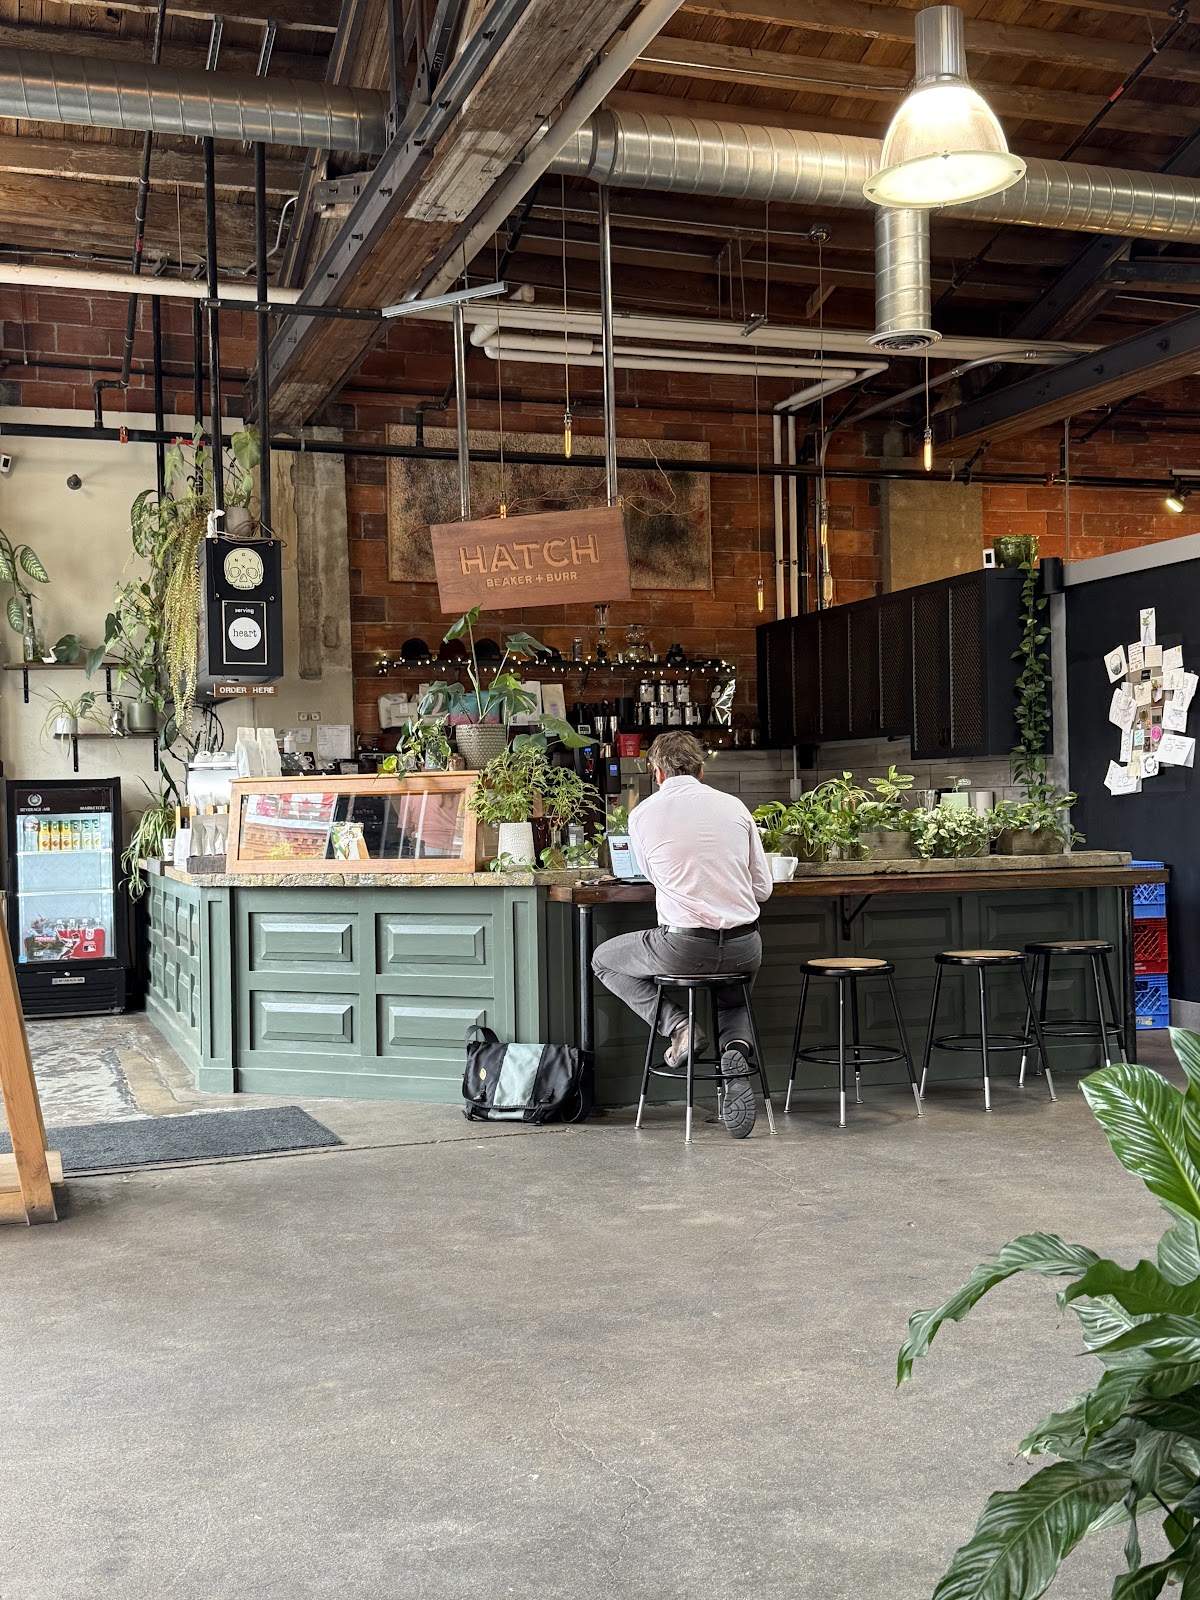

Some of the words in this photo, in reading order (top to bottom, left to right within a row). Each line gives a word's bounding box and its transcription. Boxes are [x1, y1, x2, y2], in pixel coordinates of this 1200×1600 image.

[459, 534, 600, 575] HATCH
[486, 575, 533, 588] BEAKER
[535, 574, 543, 583] +
[546, 571, 578, 583] BURR
[232, 628, 258, 638] heart
[219, 686, 247, 694] ORDER
[252, 686, 275, 694] HERE
